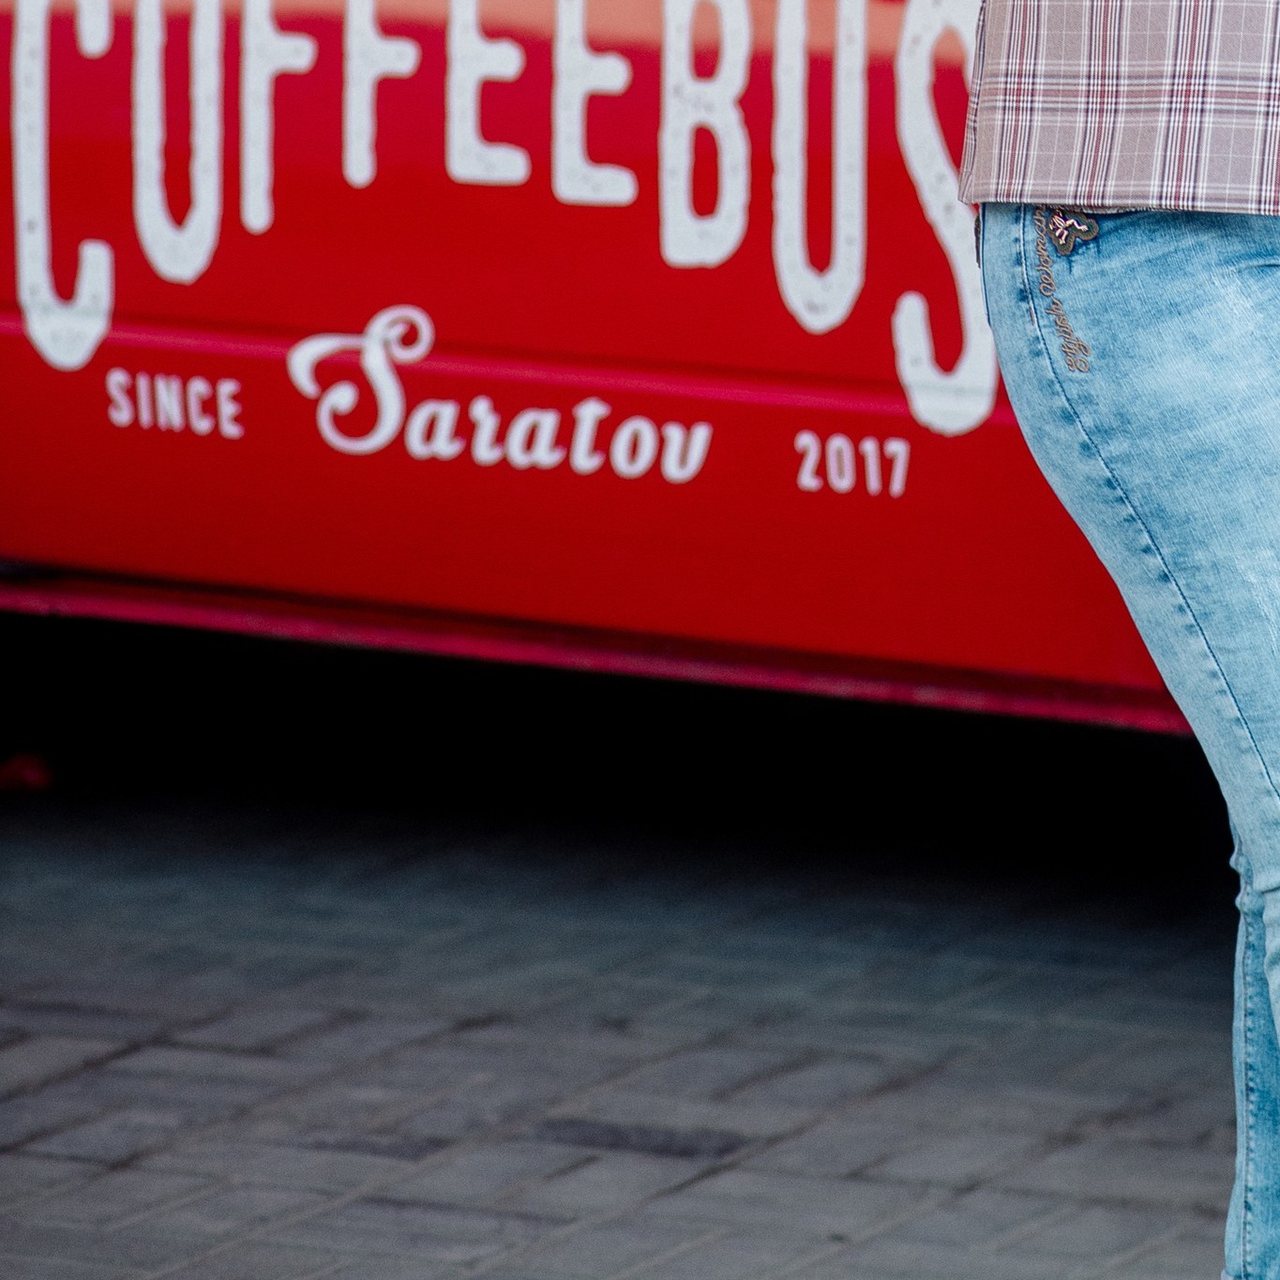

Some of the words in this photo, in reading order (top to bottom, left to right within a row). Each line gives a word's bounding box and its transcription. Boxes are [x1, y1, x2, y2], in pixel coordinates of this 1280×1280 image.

[106, 369, 244, 438] SINCE
[286, 305, 713, 482] Saratov
[795, 431, 910, 498] 2017
